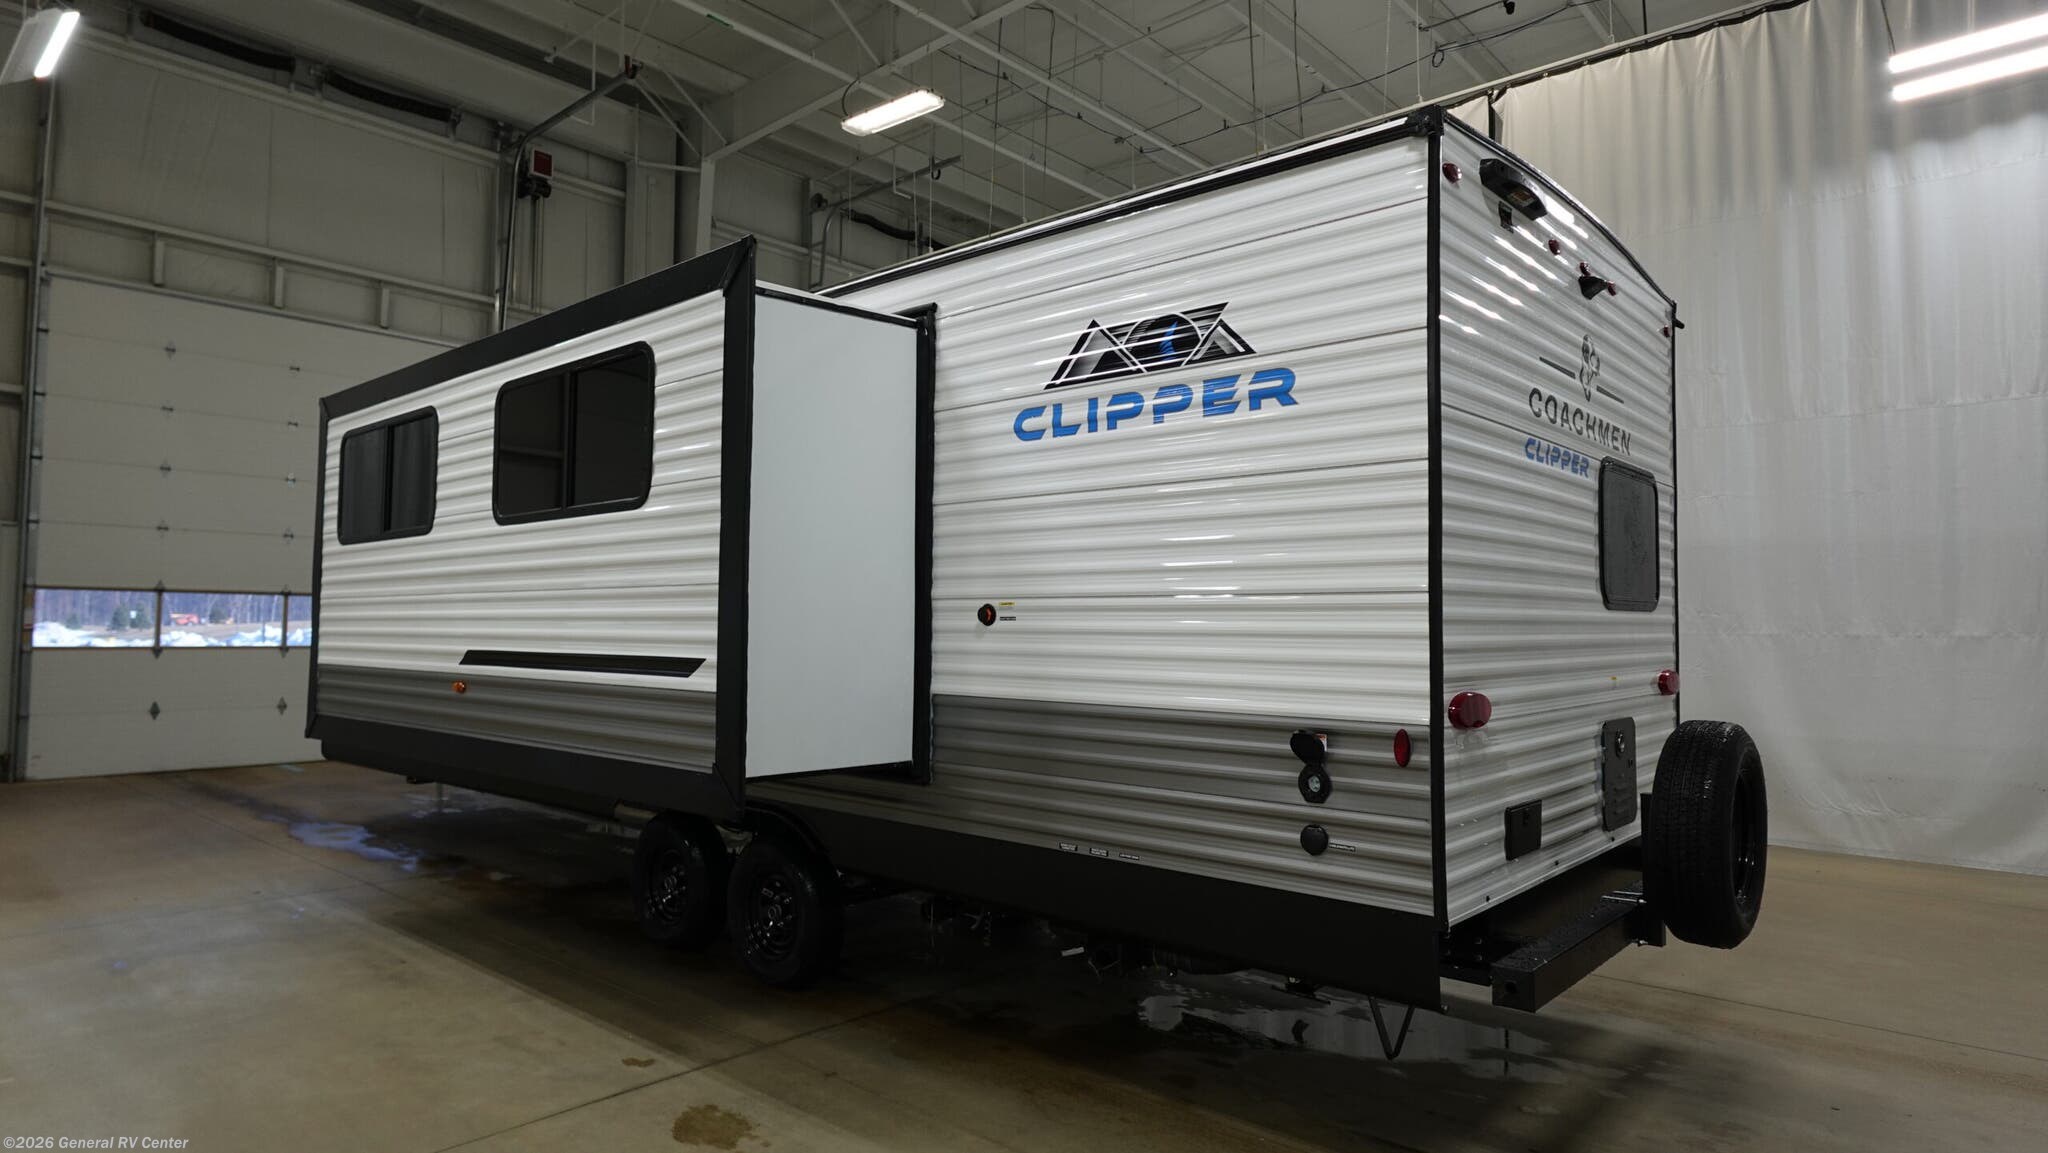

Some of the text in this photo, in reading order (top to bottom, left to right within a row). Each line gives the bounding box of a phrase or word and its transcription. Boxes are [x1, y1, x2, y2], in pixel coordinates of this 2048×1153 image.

[1013, 367, 1298, 441] CLIPPER
[1528, 387, 1632, 456] COACHMEN
[1524, 437, 1591, 478] CLIPPER
